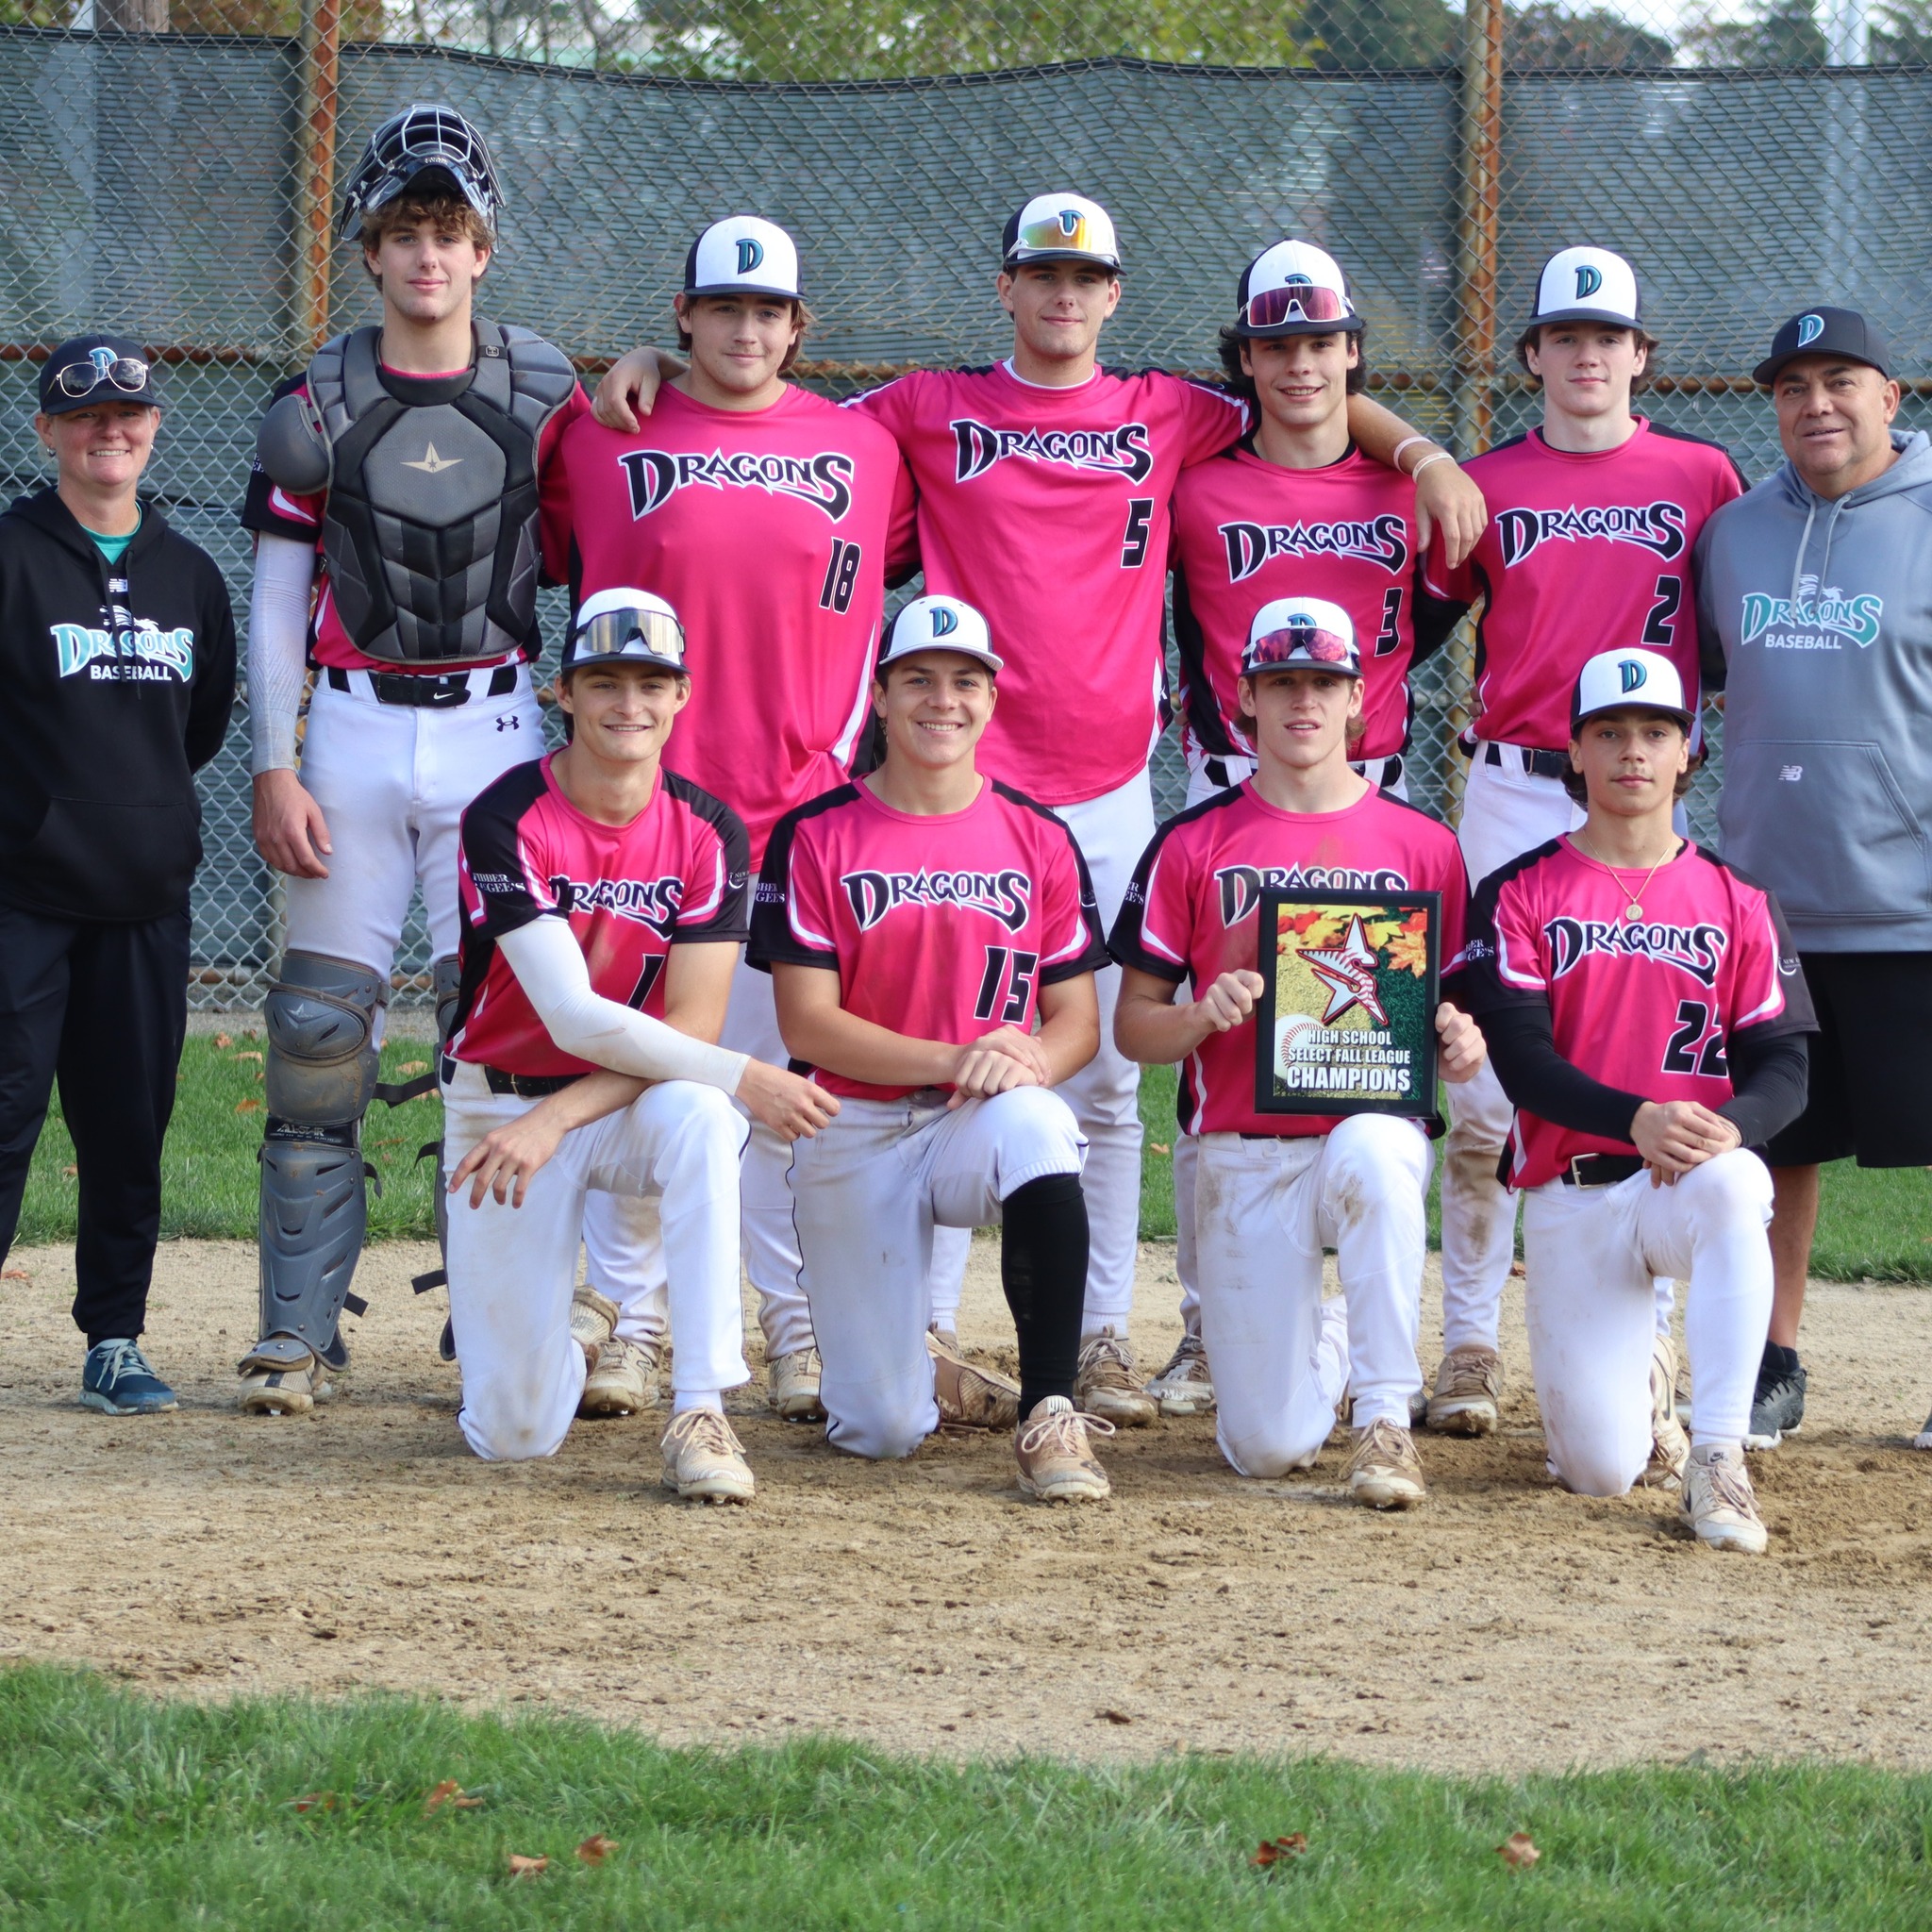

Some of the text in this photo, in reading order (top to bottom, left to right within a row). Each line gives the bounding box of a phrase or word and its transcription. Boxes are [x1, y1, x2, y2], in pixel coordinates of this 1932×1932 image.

[735, 238, 764, 275] D
[1574, 264, 1603, 300] D
[1798, 314, 1824, 347] D
[949, 418, 1154, 487] DRAGONS
[617, 446, 855, 525] DRAGONS
[1120, 497, 1155, 568] 5
[1217, 513, 1407, 585] DRAGONS
[1494, 500, 1686, 570] DRAGONS
[819, 536, 861, 615] 18
[929, 607, 958, 638] D
[1374, 587, 1404, 658] 3
[1641, 574, 1681, 646] 2
[1740, 591, 1883, 649] DRAGONS
[1764, 633, 1842, 650] BASEBALL
[49, 623, 194, 683] DRAGONS
[91, 664, 173, 681] BASEBALL
[1618, 658, 1648, 694] D
[548, 873, 685, 941] DRAGONS
[840, 866, 1032, 936] DRAGONS
[626, 953, 666, 1011] 1
[973, 944, 1040, 1025] 15
[1543, 915, 1729, 990] DRAGONS
[1288, 1047, 1411, 1064] SELECT FALL LEAGUE
[1307, 1029, 1392, 1045] HIGH SCHOOL
[1660, 999, 1729, 1079] 22
[1286, 1065, 1411, 1092] CHAMPIONS
